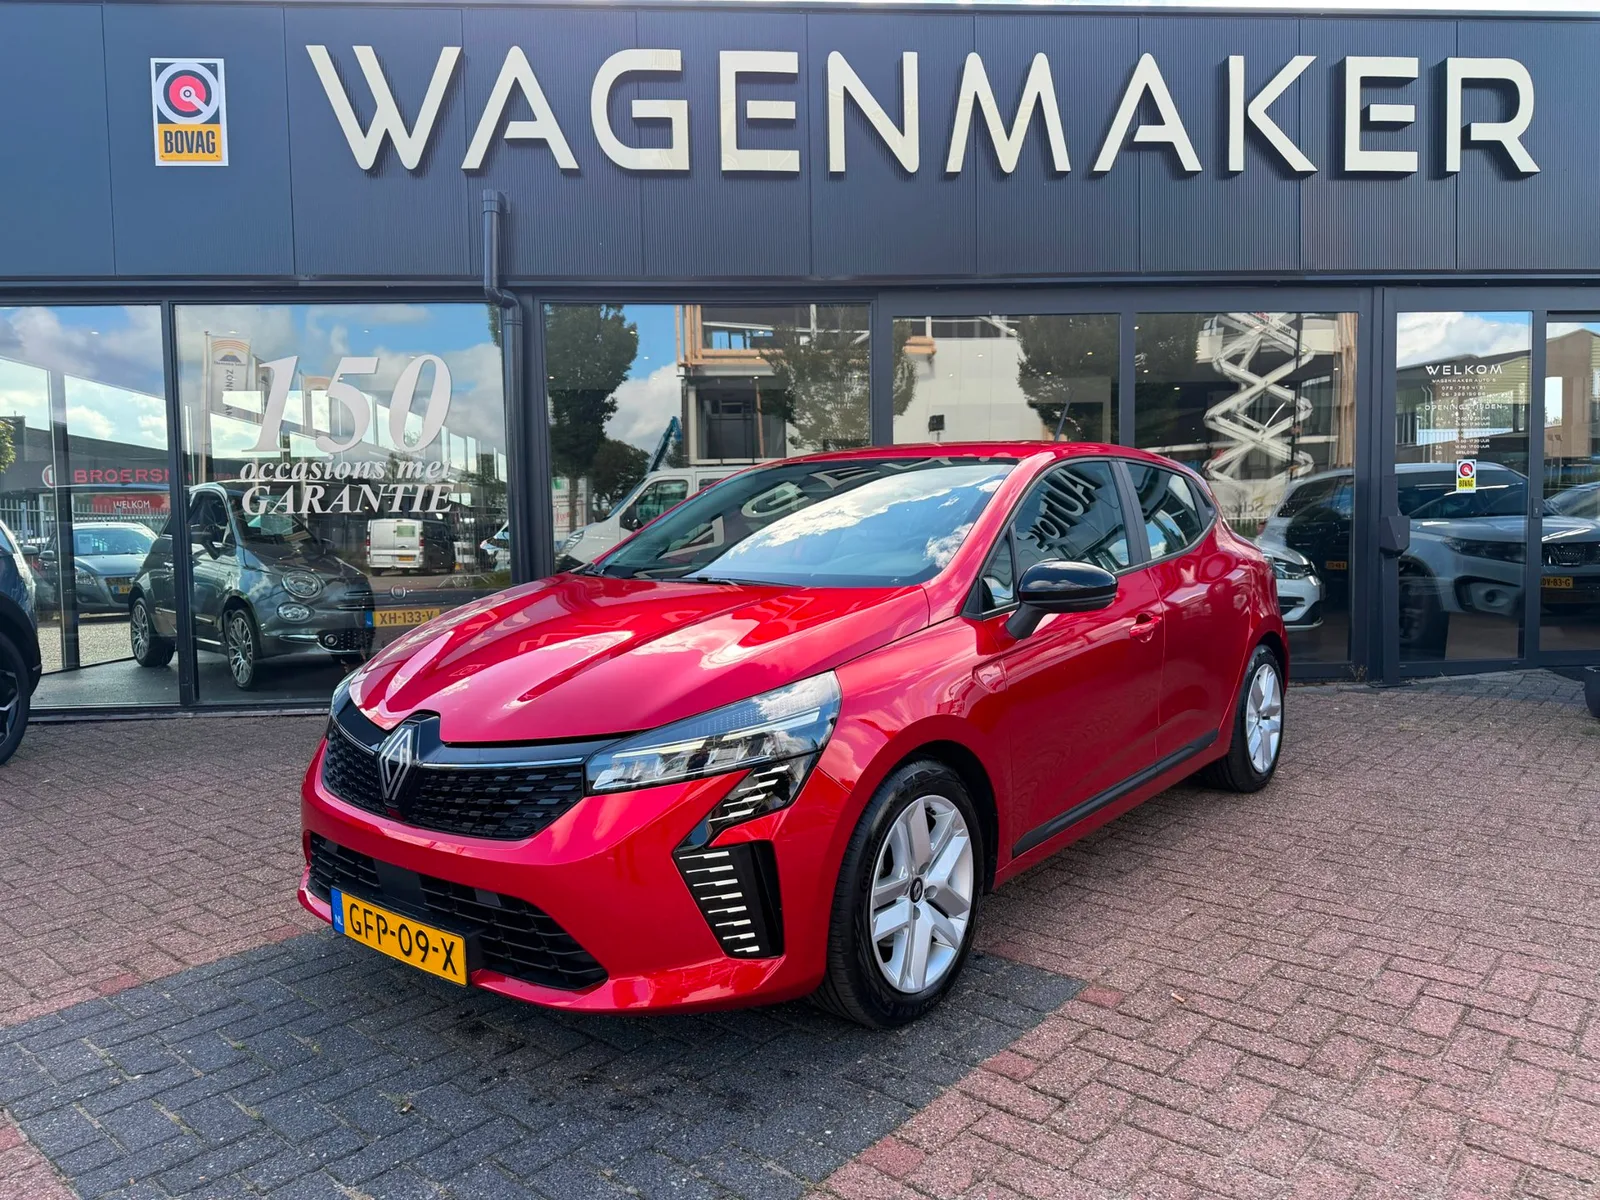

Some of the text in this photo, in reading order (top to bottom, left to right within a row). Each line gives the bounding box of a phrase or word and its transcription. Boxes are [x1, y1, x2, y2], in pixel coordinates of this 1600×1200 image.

[305, 45, 1541, 173] WAGENMAKER
[163, 130, 216, 154] BOVAG
[1425, 364, 1503, 375] WELKOM
[242, 354, 453, 453] 150
[239, 454, 452, 481] occasions met
[112, 500, 151, 509] WELKOM
[241, 484, 455, 516] GARANTIE
[379, 610, 434, 625] XH-133-V
[334, 914, 344, 927] NL
[349, 902, 458, 976] GFP-09-X
